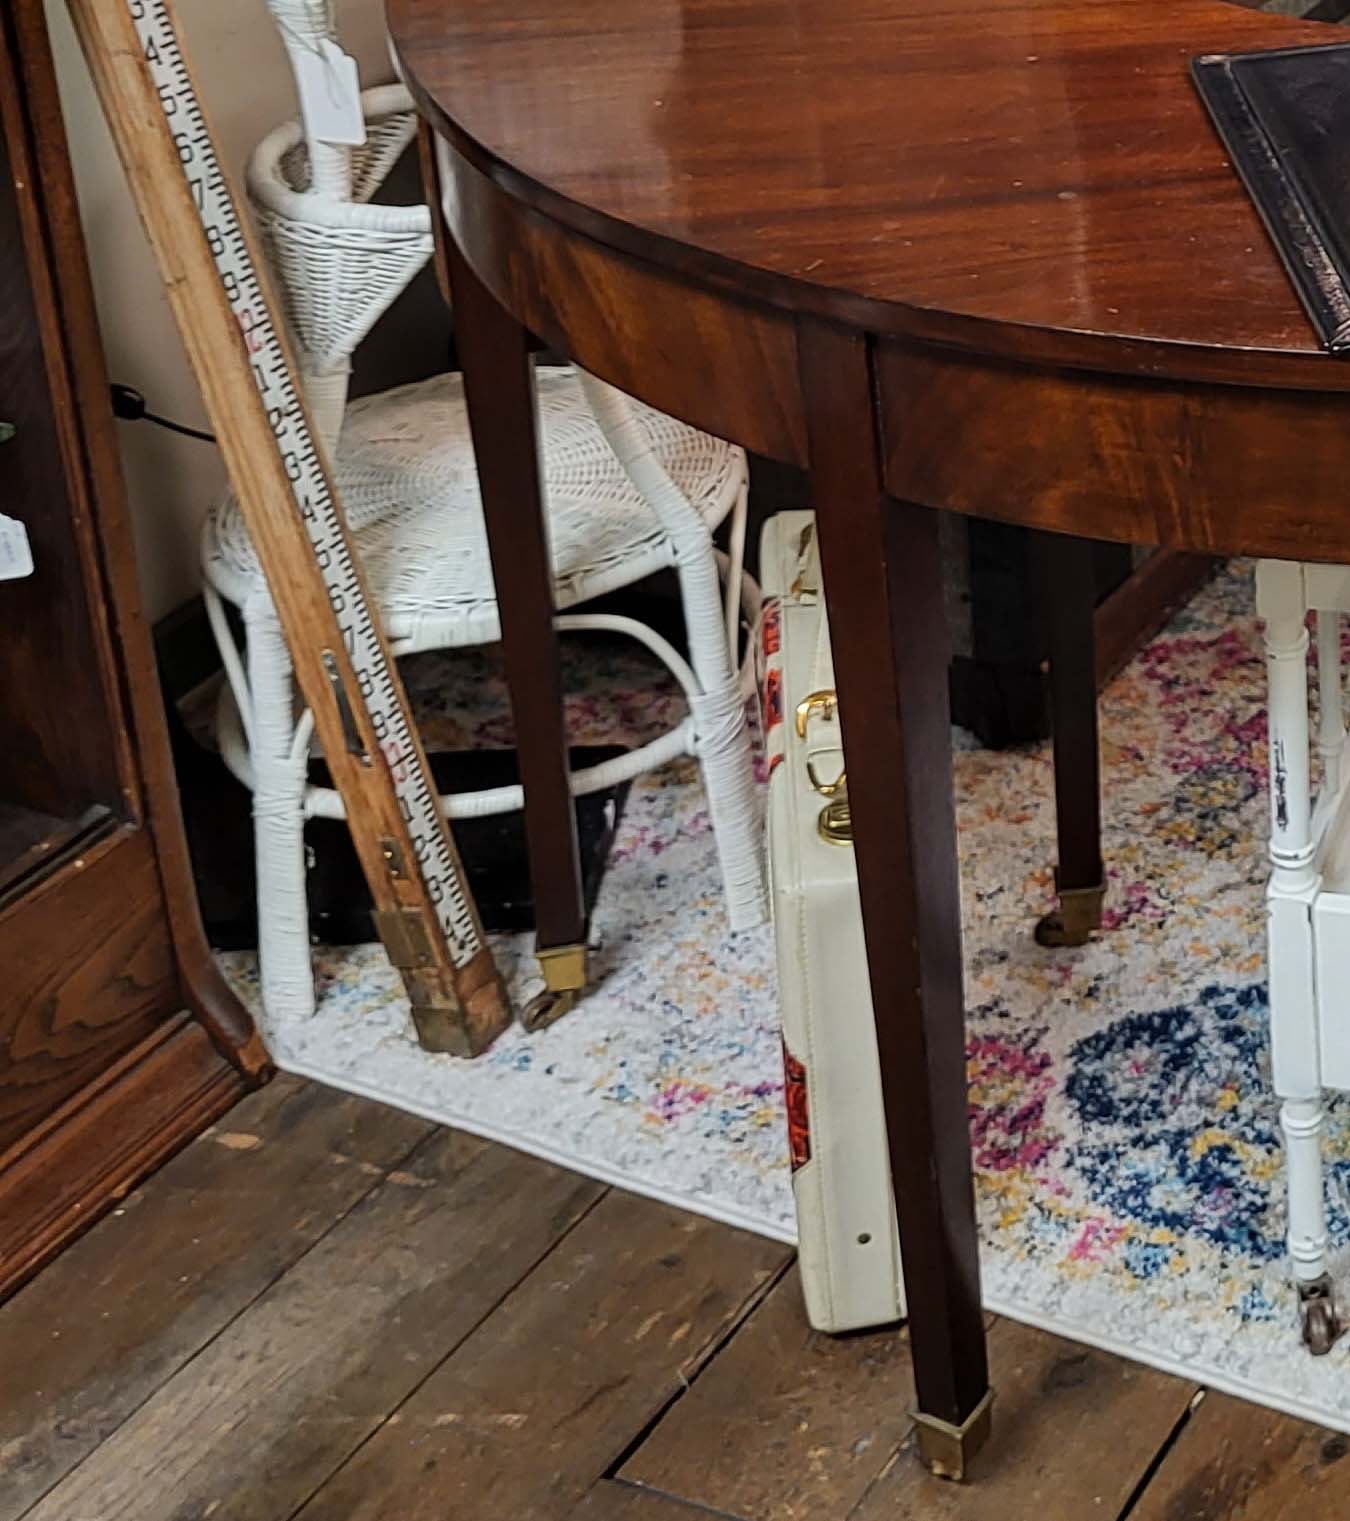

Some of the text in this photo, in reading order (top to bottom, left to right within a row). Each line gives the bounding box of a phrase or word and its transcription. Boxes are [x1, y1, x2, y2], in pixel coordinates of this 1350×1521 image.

[145, 36, 161, 66] 4
[158, 86, 177, 116] 5
[174, 133, 193, 164] 6
[206, 226, 224, 257] 8
[222, 271, 241, 302] 9
[253, 364, 270, 392] 1
[267, 407, 287, 438] 2
[283, 453, 302, 482] 3
[300, 496, 317, 525] 4
[313, 539, 329, 570] 5
[329, 584, 345, 614] 6
[358, 668, 374, 698] 8
[372, 710, 388, 739] 9
